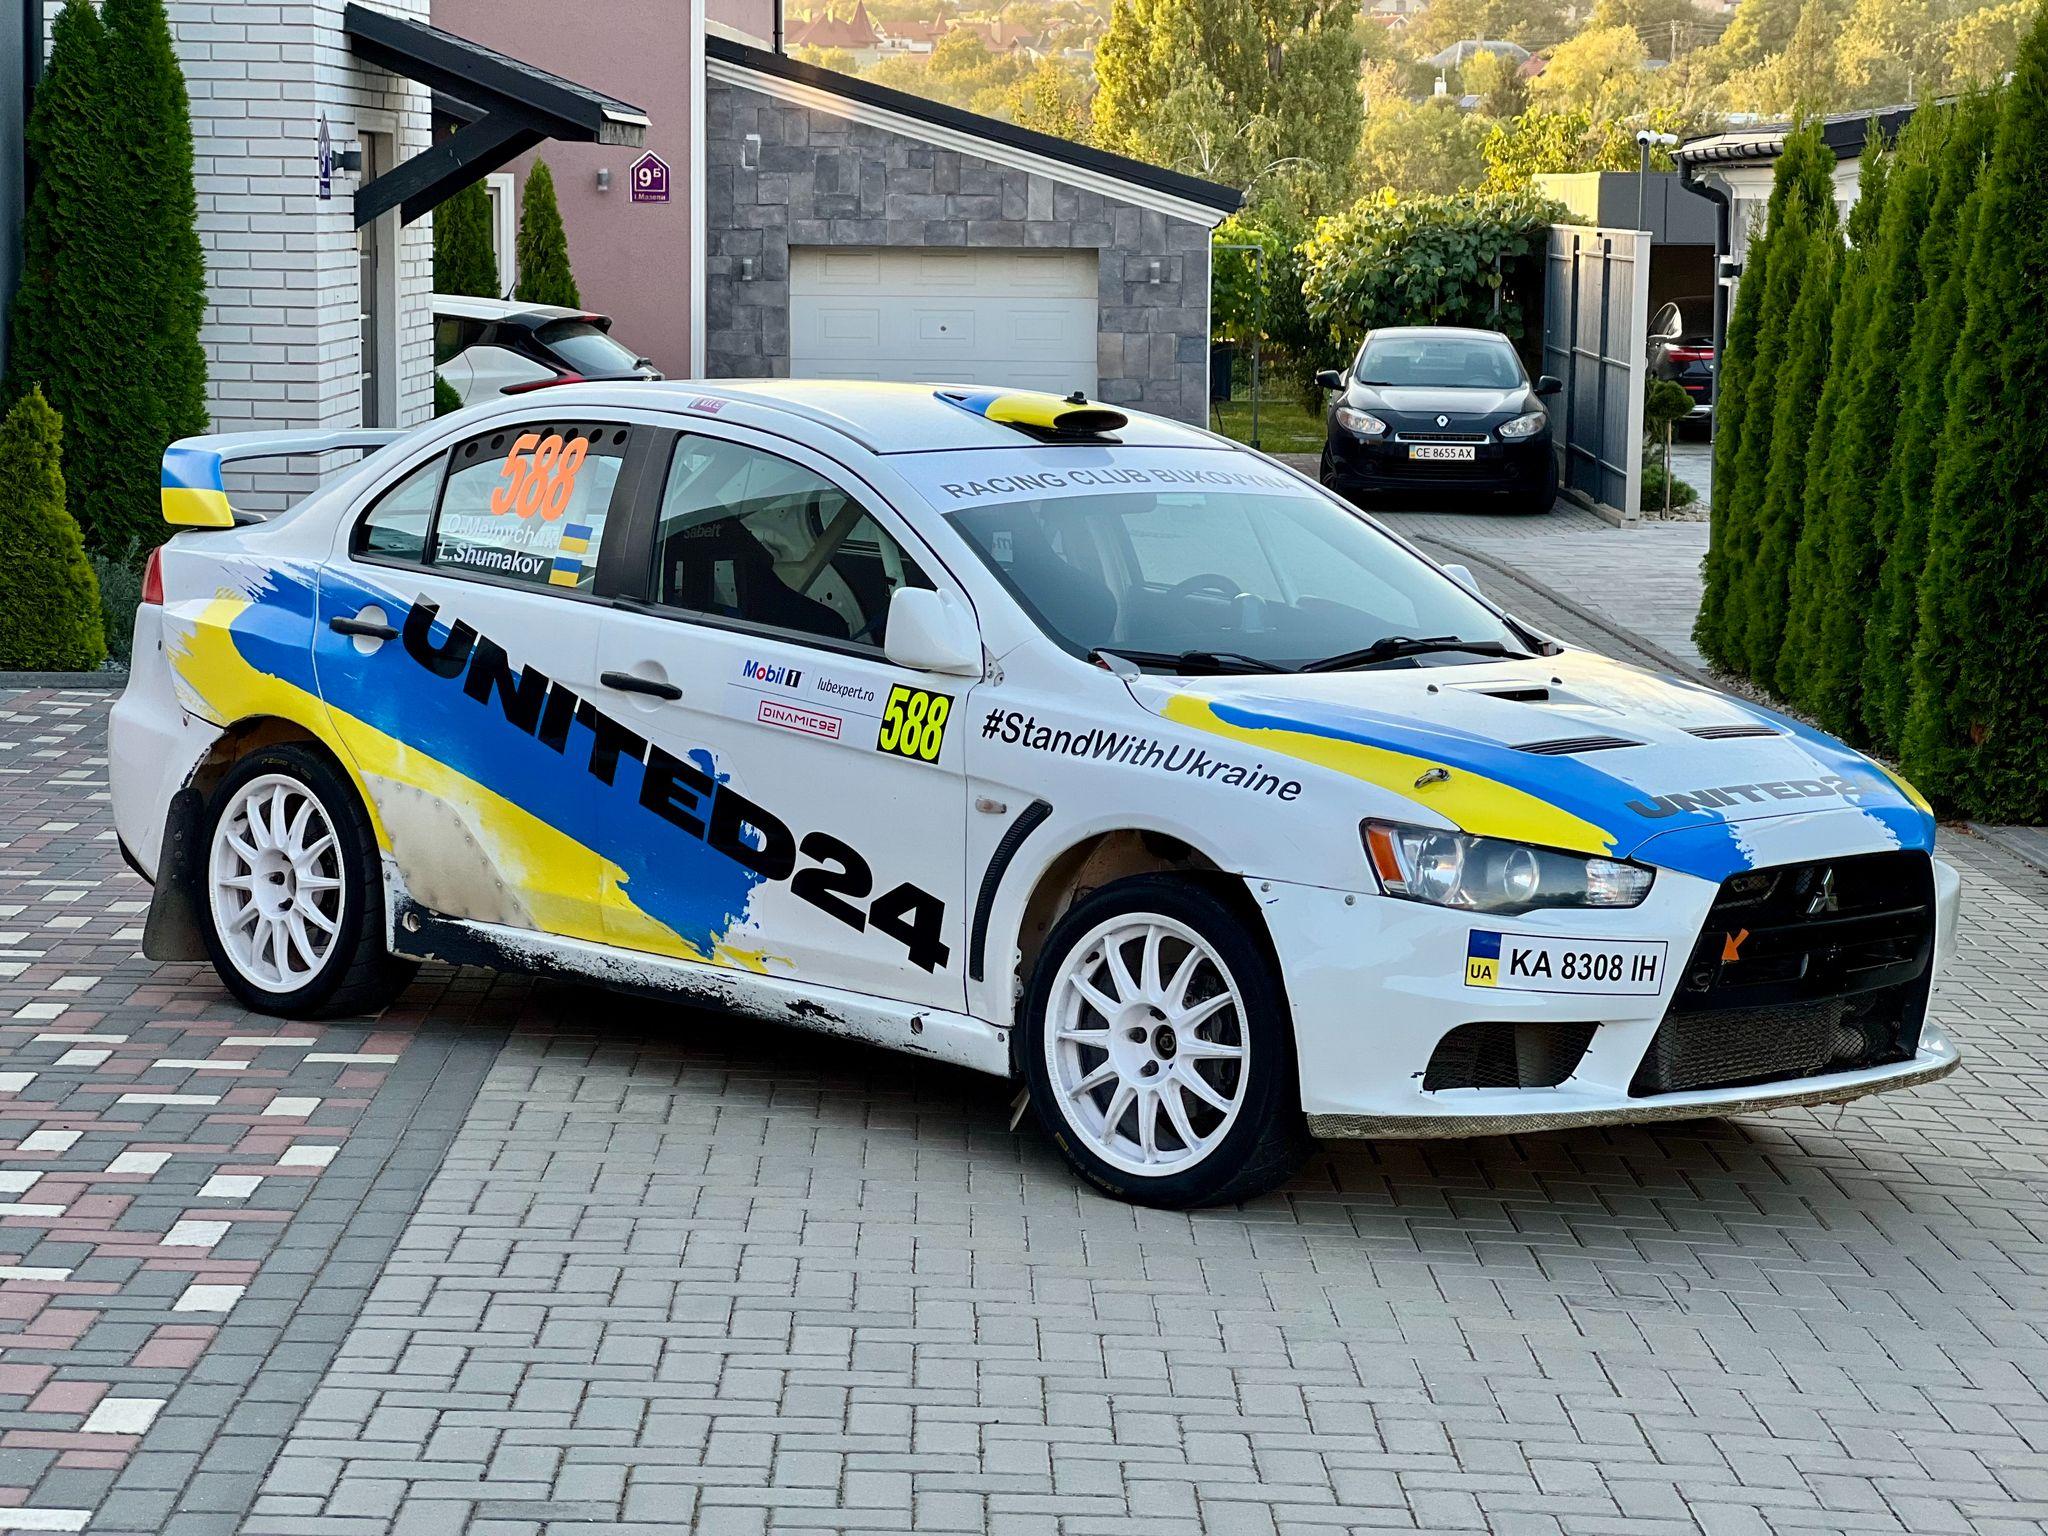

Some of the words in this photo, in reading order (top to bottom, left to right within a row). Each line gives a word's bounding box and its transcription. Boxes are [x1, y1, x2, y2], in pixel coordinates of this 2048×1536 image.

[1416, 447, 1431, 458] CE
[1433, 447, 1456, 459] 8655
[1458, 448, 1473, 459] AX
[491, 433, 589, 522] 588
[939, 473, 1065, 499] RACING
[1067, 469, 1151, 486] CLUB
[1148, 468, 1301, 491] BUKOVYNA
[438, 539, 545, 575] L.Shumakov
[742, 659, 786, 685] Mobil
[784, 668, 803, 688] 1
[817, 676, 875, 702] lubexpert.ro
[763, 706, 837, 733] DINAMIC92
[880, 686, 949, 761] 588
[981, 708, 1302, 801] #StandWithUkraine
[402, 592, 951, 975] UNITED24
[1470, 964, 1492, 980] UA
[1510, 948, 1553, 979] KA
[1561, 952, 1624, 982] 8308
[1631, 955, 1658, 982] IH
